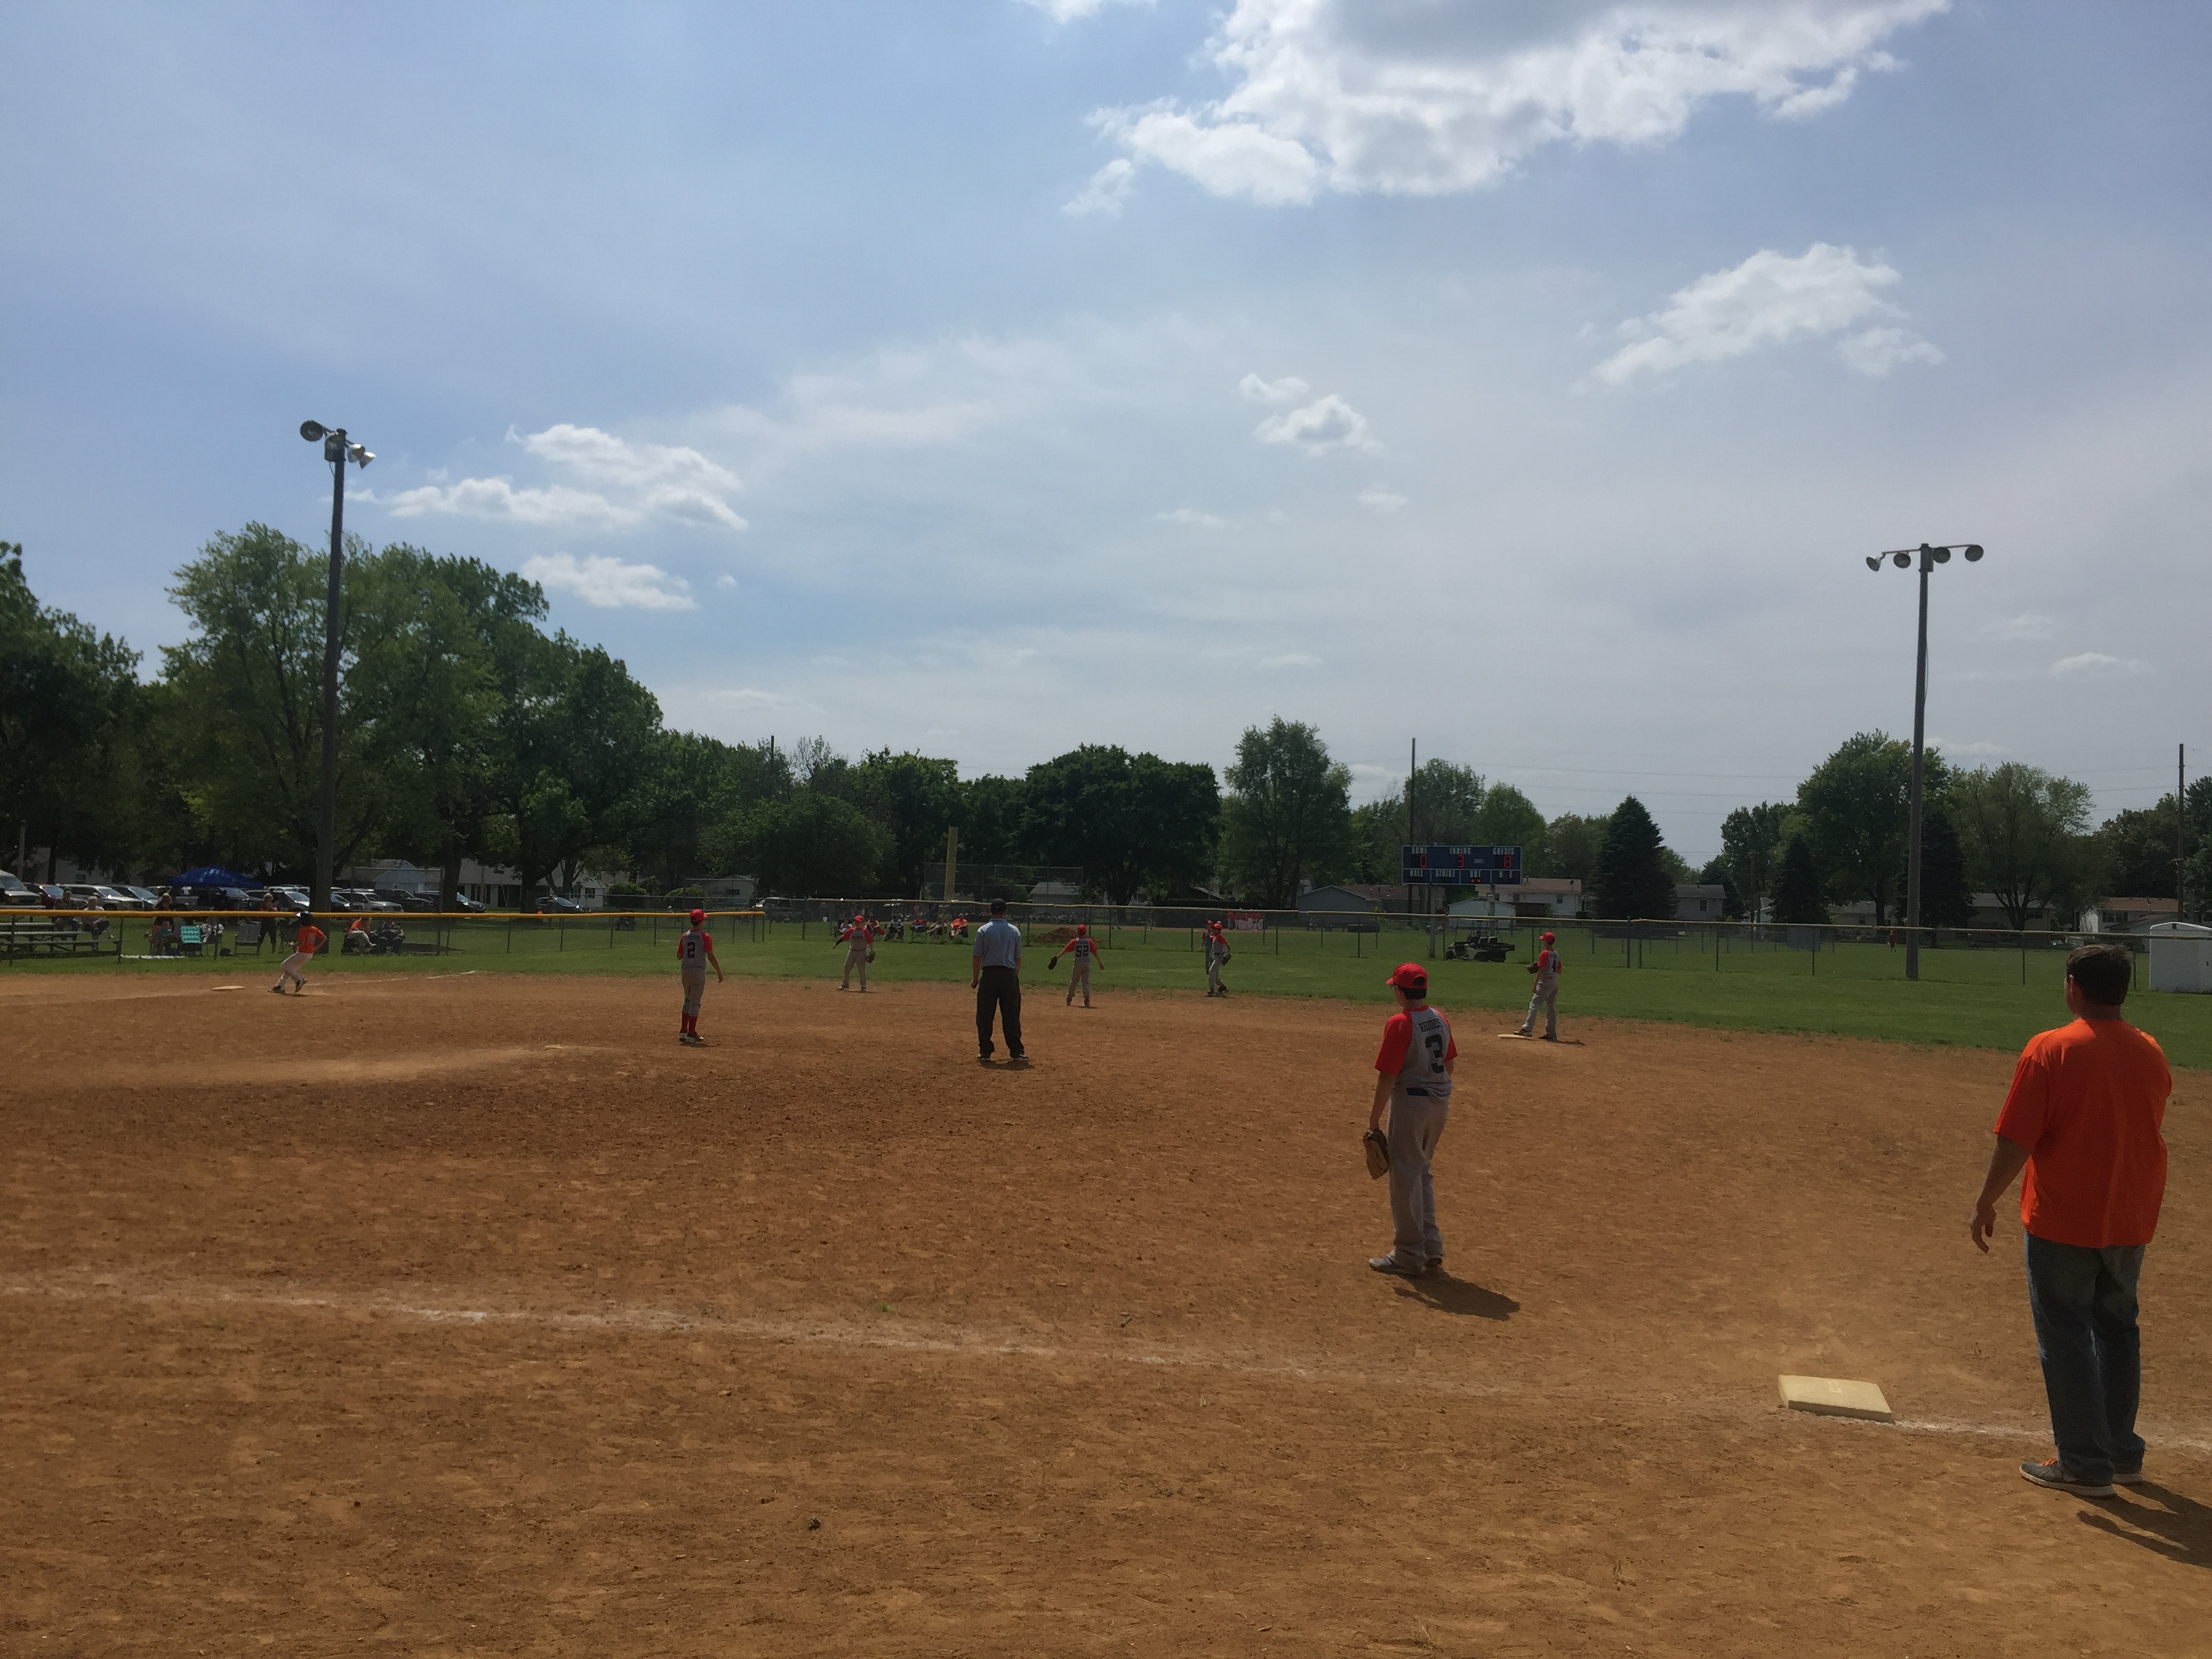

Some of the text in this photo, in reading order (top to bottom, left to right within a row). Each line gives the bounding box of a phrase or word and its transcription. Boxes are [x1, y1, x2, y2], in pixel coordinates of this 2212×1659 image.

[1420, 855, 1427, 867] 0
[1458, 855, 1465, 867] 3
[1504, 855, 1512, 868] 8
[687, 941, 695, 958] 2
[1076, 945, 1089, 957] 52
[1551, 959, 1557, 972] 4
[1425, 1033, 1443, 1073] 3
